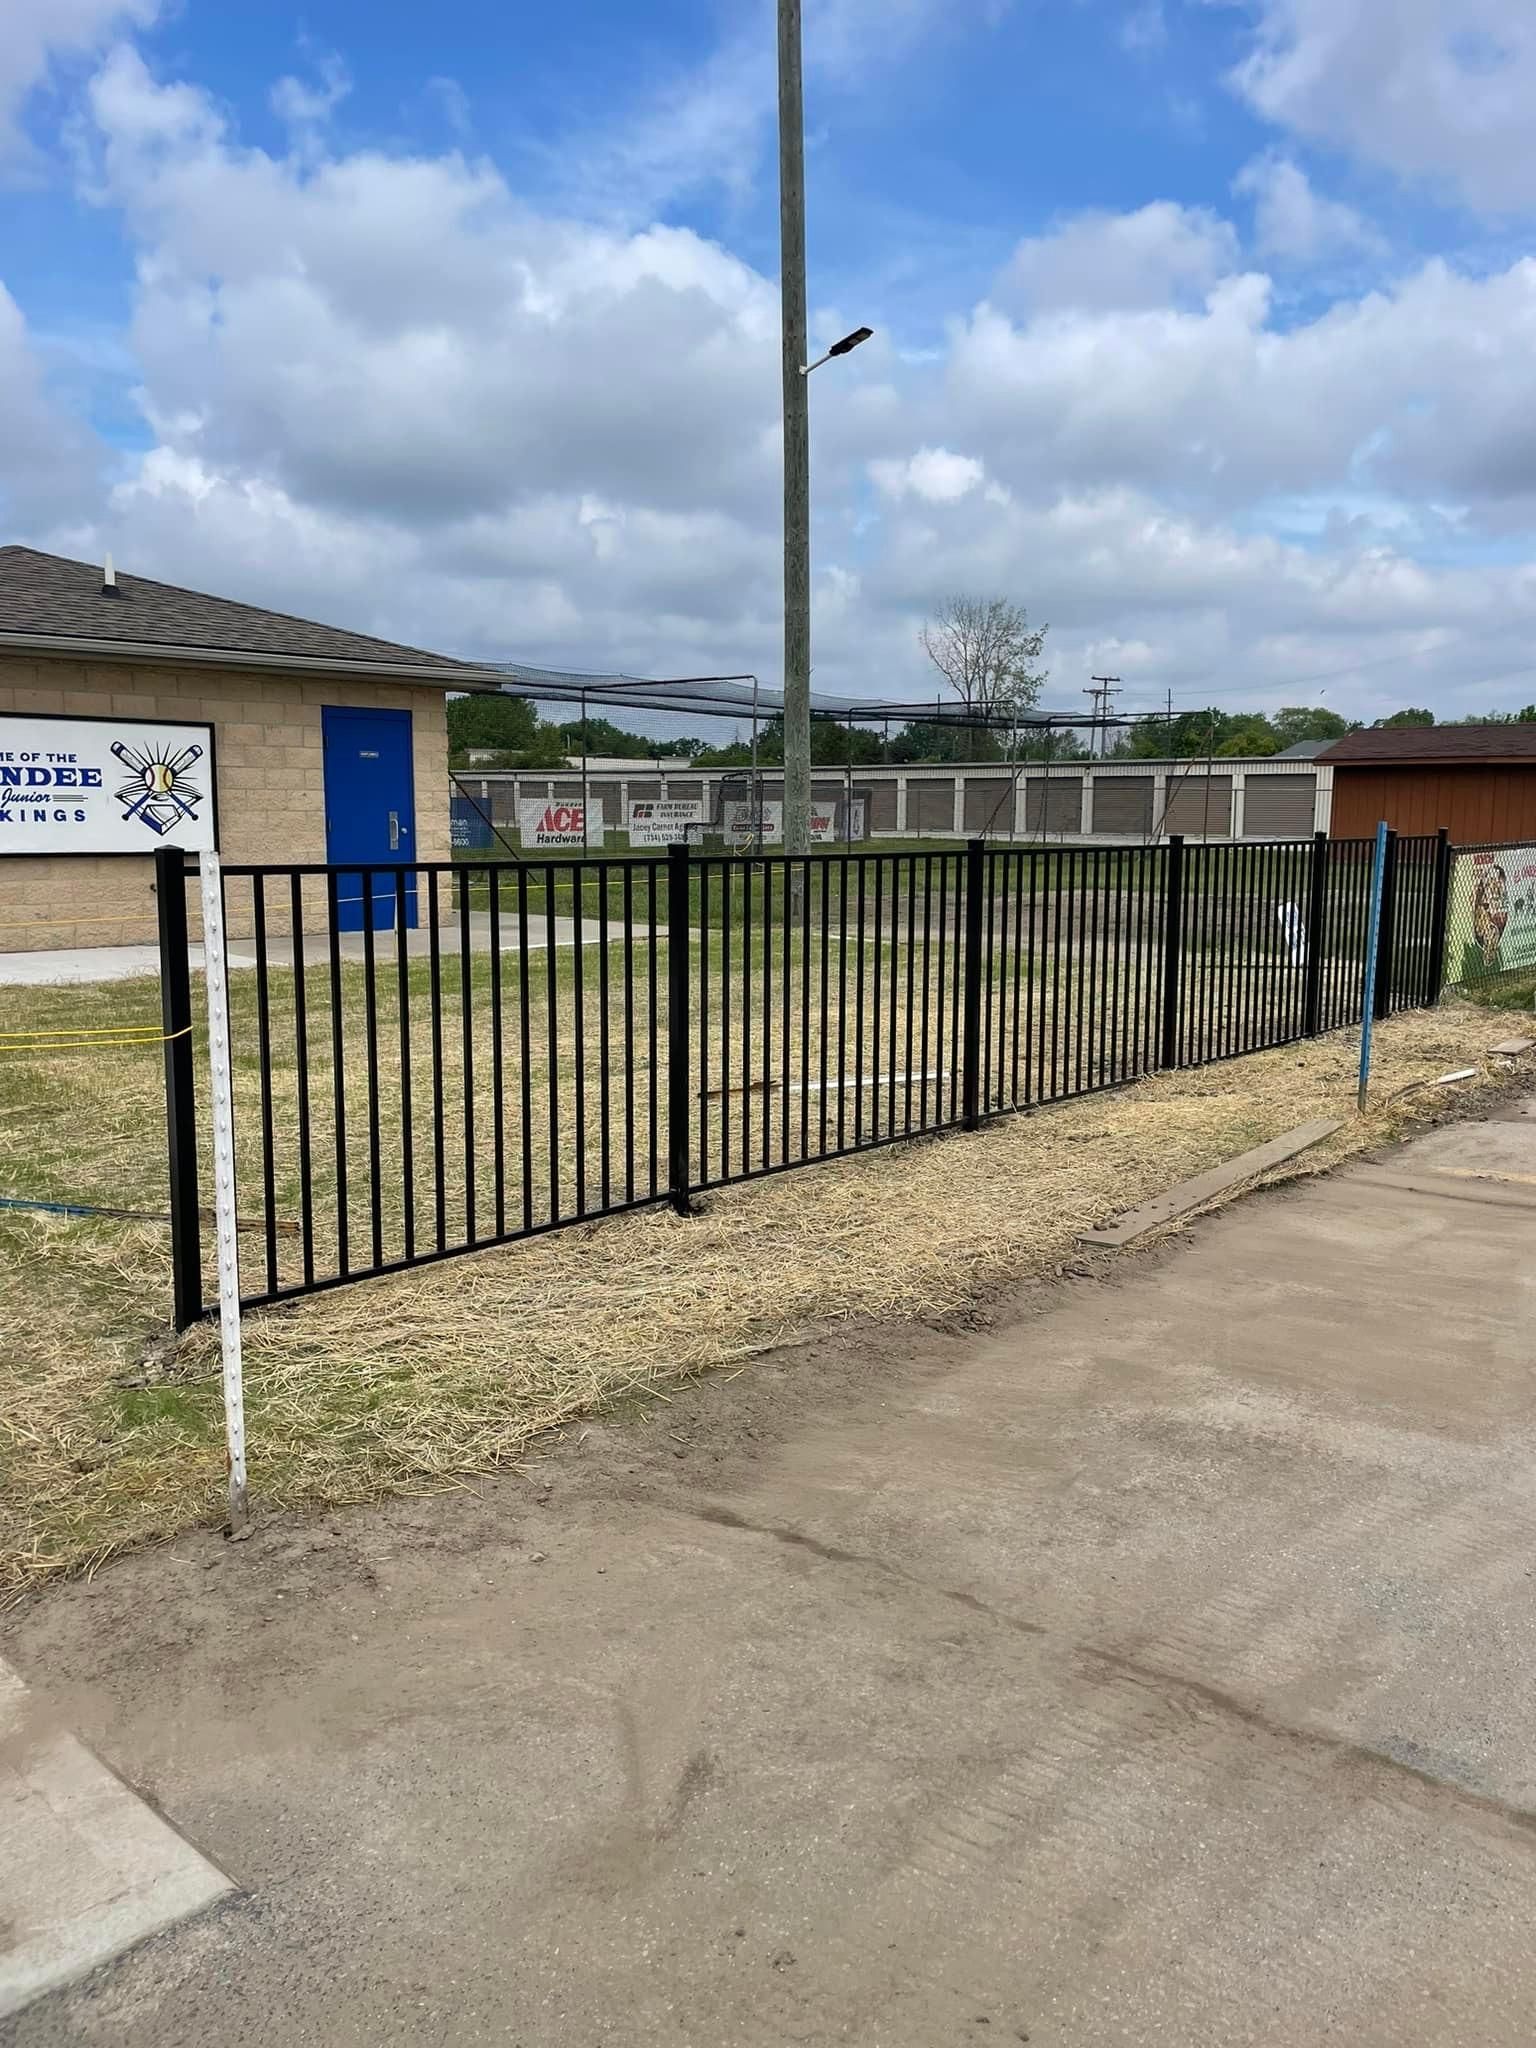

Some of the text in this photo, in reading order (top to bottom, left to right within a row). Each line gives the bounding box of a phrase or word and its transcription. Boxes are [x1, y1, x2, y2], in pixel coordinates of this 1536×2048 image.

[20, 753, 41, 762] OF
[46, 754, 78, 763] THE
[0, 766, 102, 787] NDEE
[1, 788, 51, 808] Junior
[0, 808, 86, 822] KINGS
[536, 806, 585, 833] ACE
